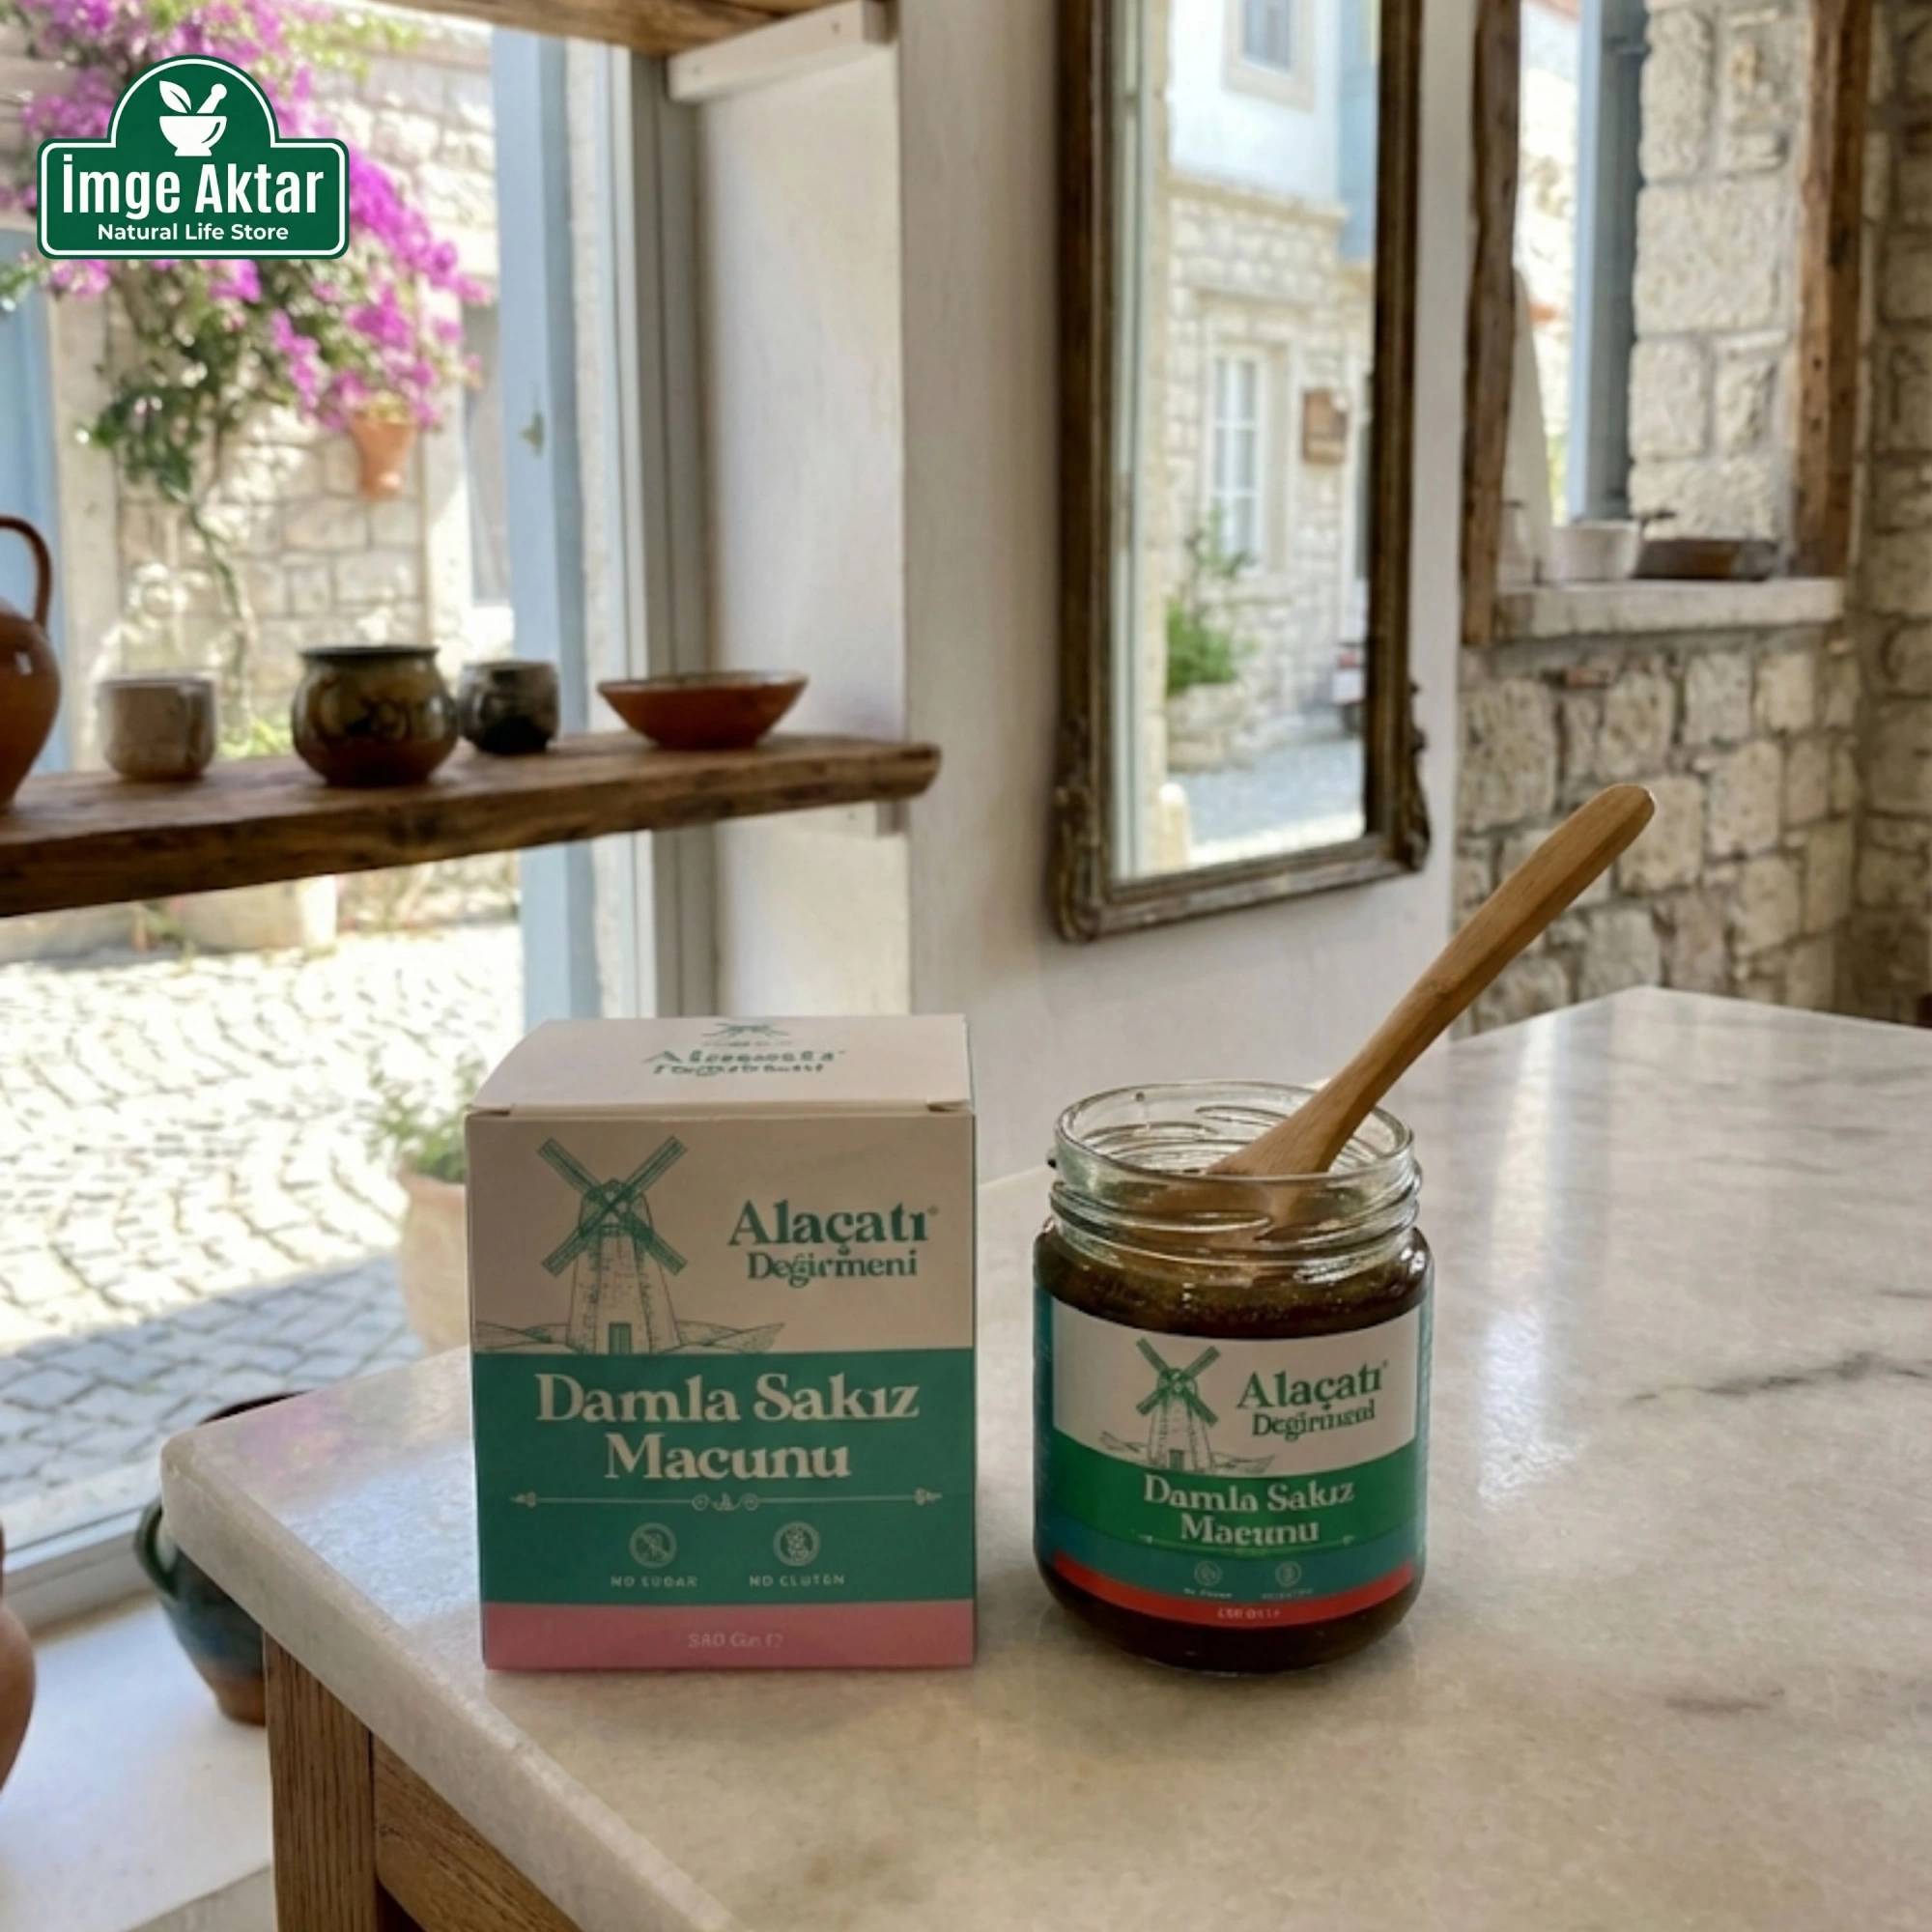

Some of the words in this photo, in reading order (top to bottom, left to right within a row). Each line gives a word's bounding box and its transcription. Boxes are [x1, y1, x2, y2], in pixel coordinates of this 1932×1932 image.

[727, 1199, 929, 1256] Alaçatı
[534, 1373, 741, 1422] Damla
[753, 1372, 921, 1421] Sakız
[605, 1432, 852, 1480] Macunu
[1143, 1473, 1258, 1512] Damla
